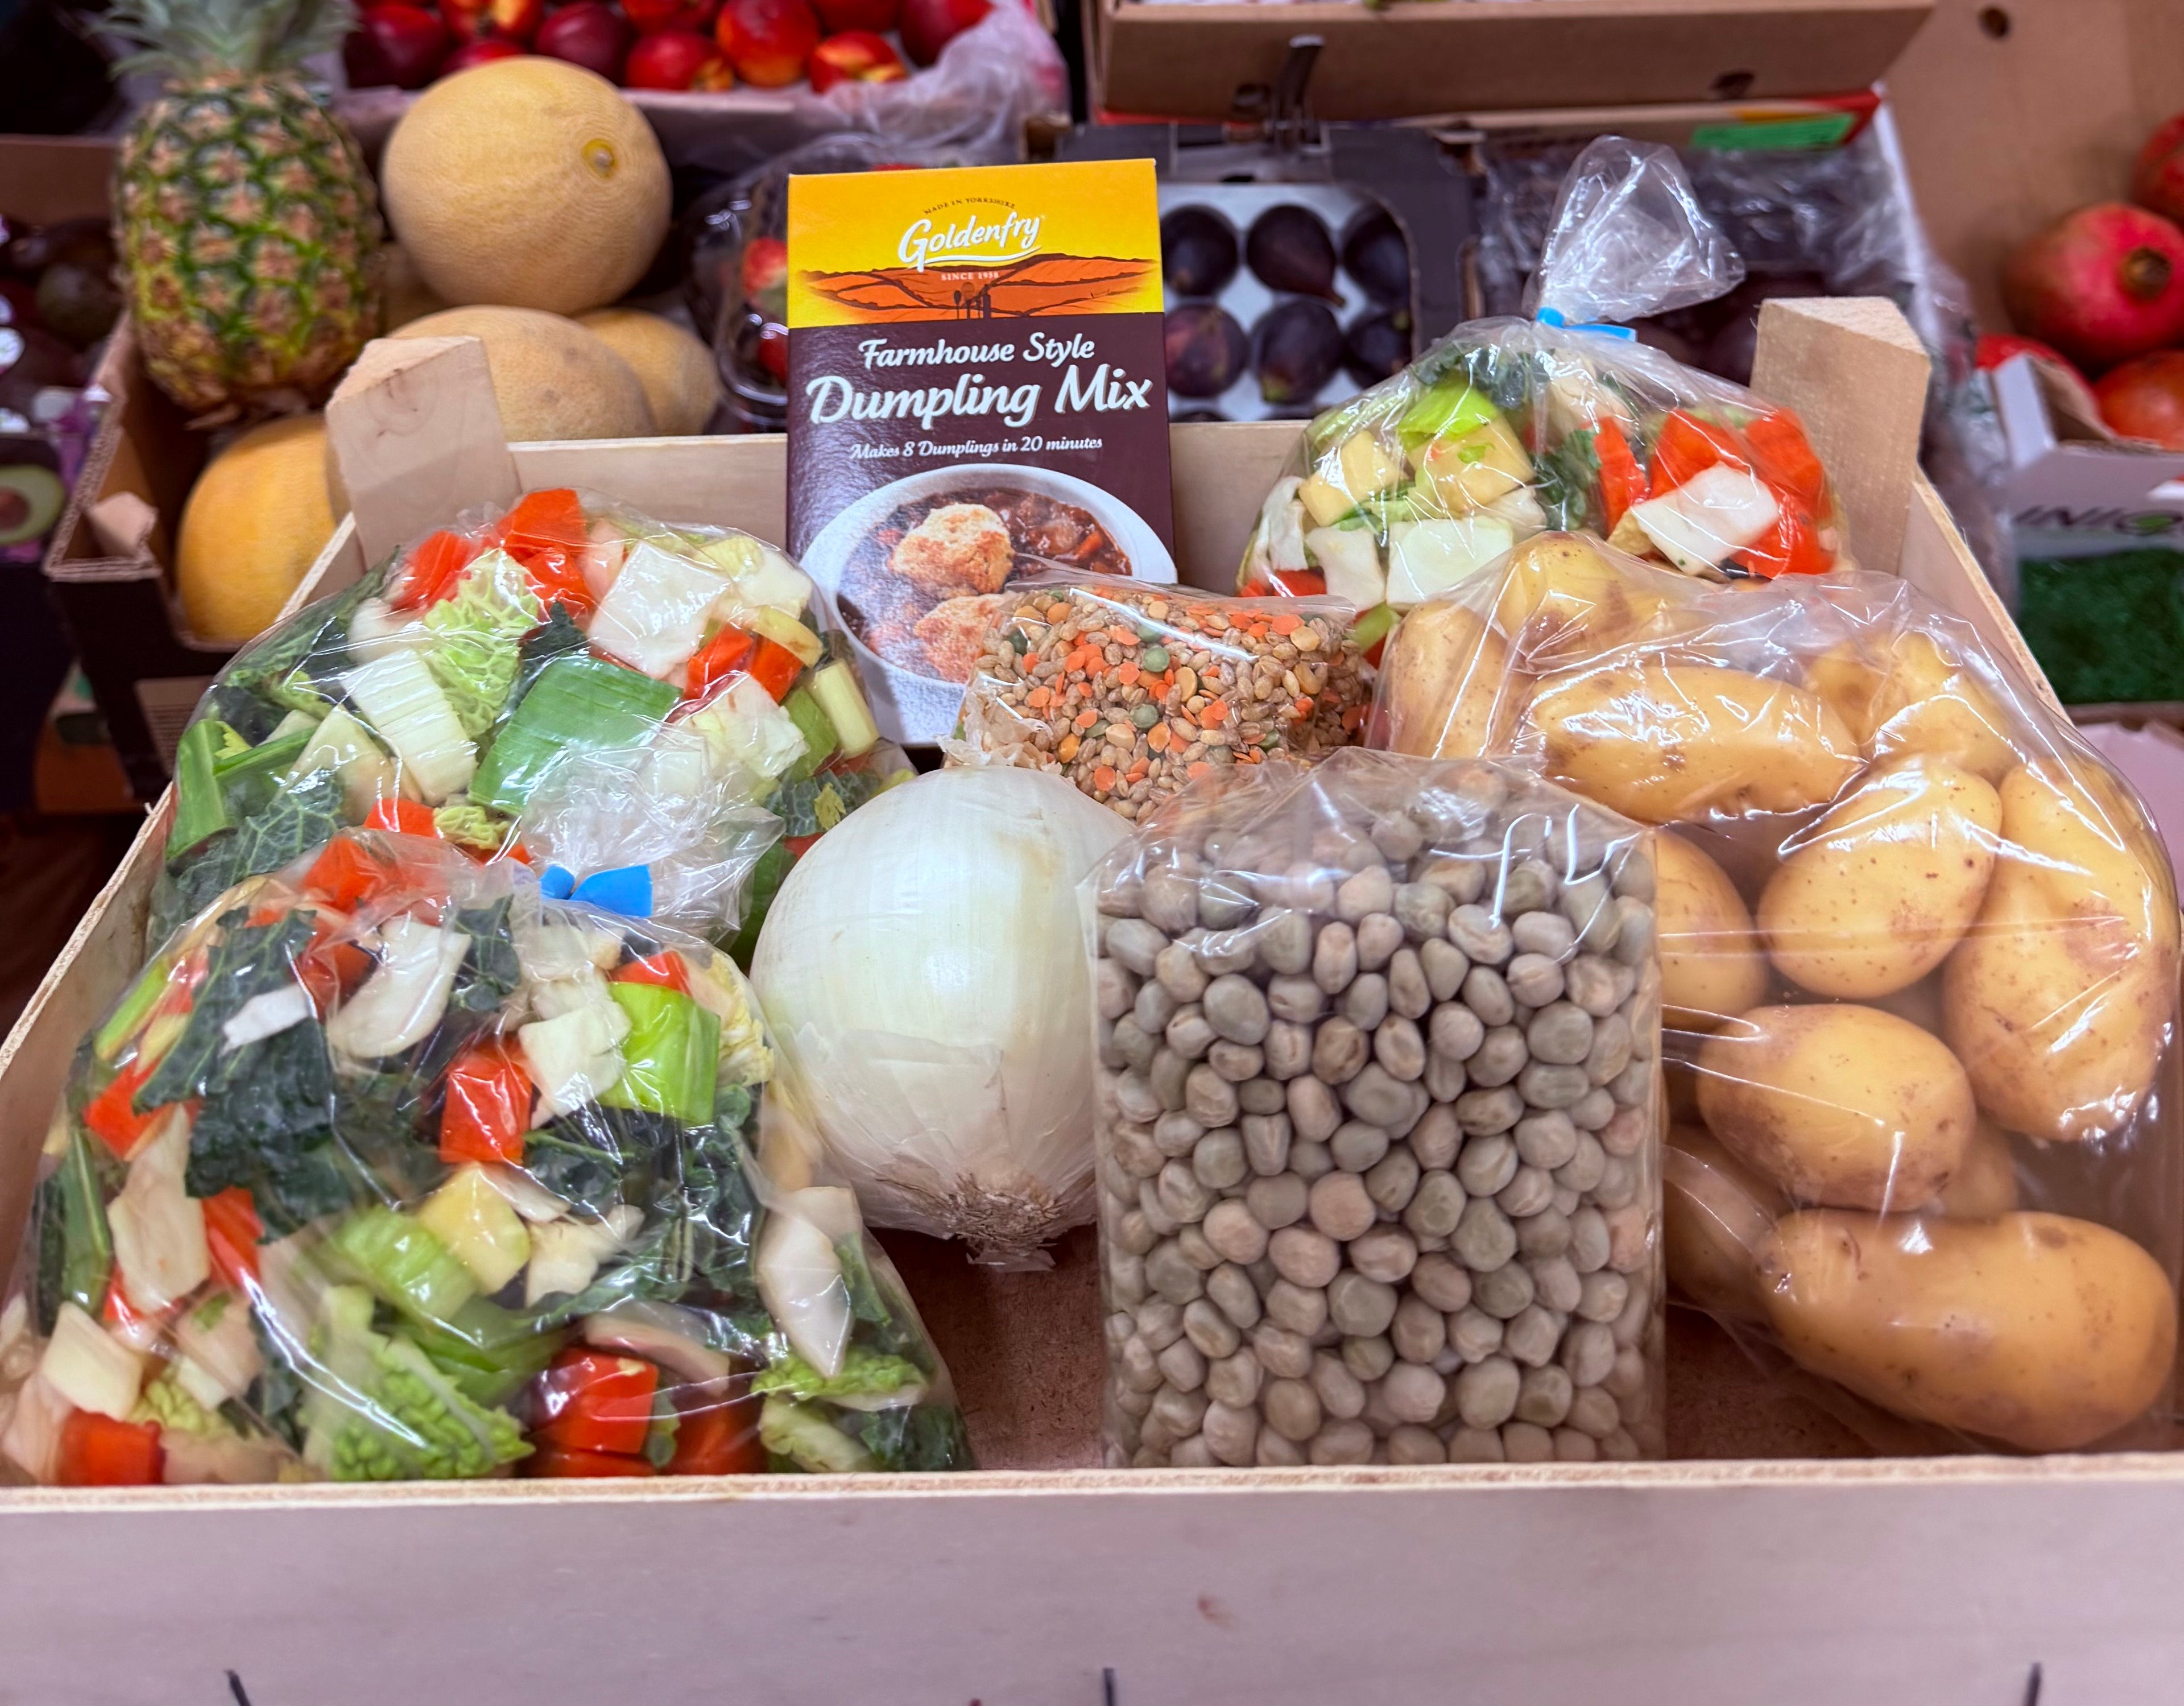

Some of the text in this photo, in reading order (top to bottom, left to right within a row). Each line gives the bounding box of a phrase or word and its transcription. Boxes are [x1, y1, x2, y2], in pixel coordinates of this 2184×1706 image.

[924, 203, 949, 214] MADE
[965, 197, 1015, 209] YORKSHIRE
[898, 211, 1040, 273] Goldenfry
[941, 272, 973, 281] SINCE
[858, 332, 1095, 370] Farmhouse Style
[805, 363, 1153, 431] Dumpling Mix
[851, 436, 1103, 459] Makes 8 Dumplings in 20 minutes
